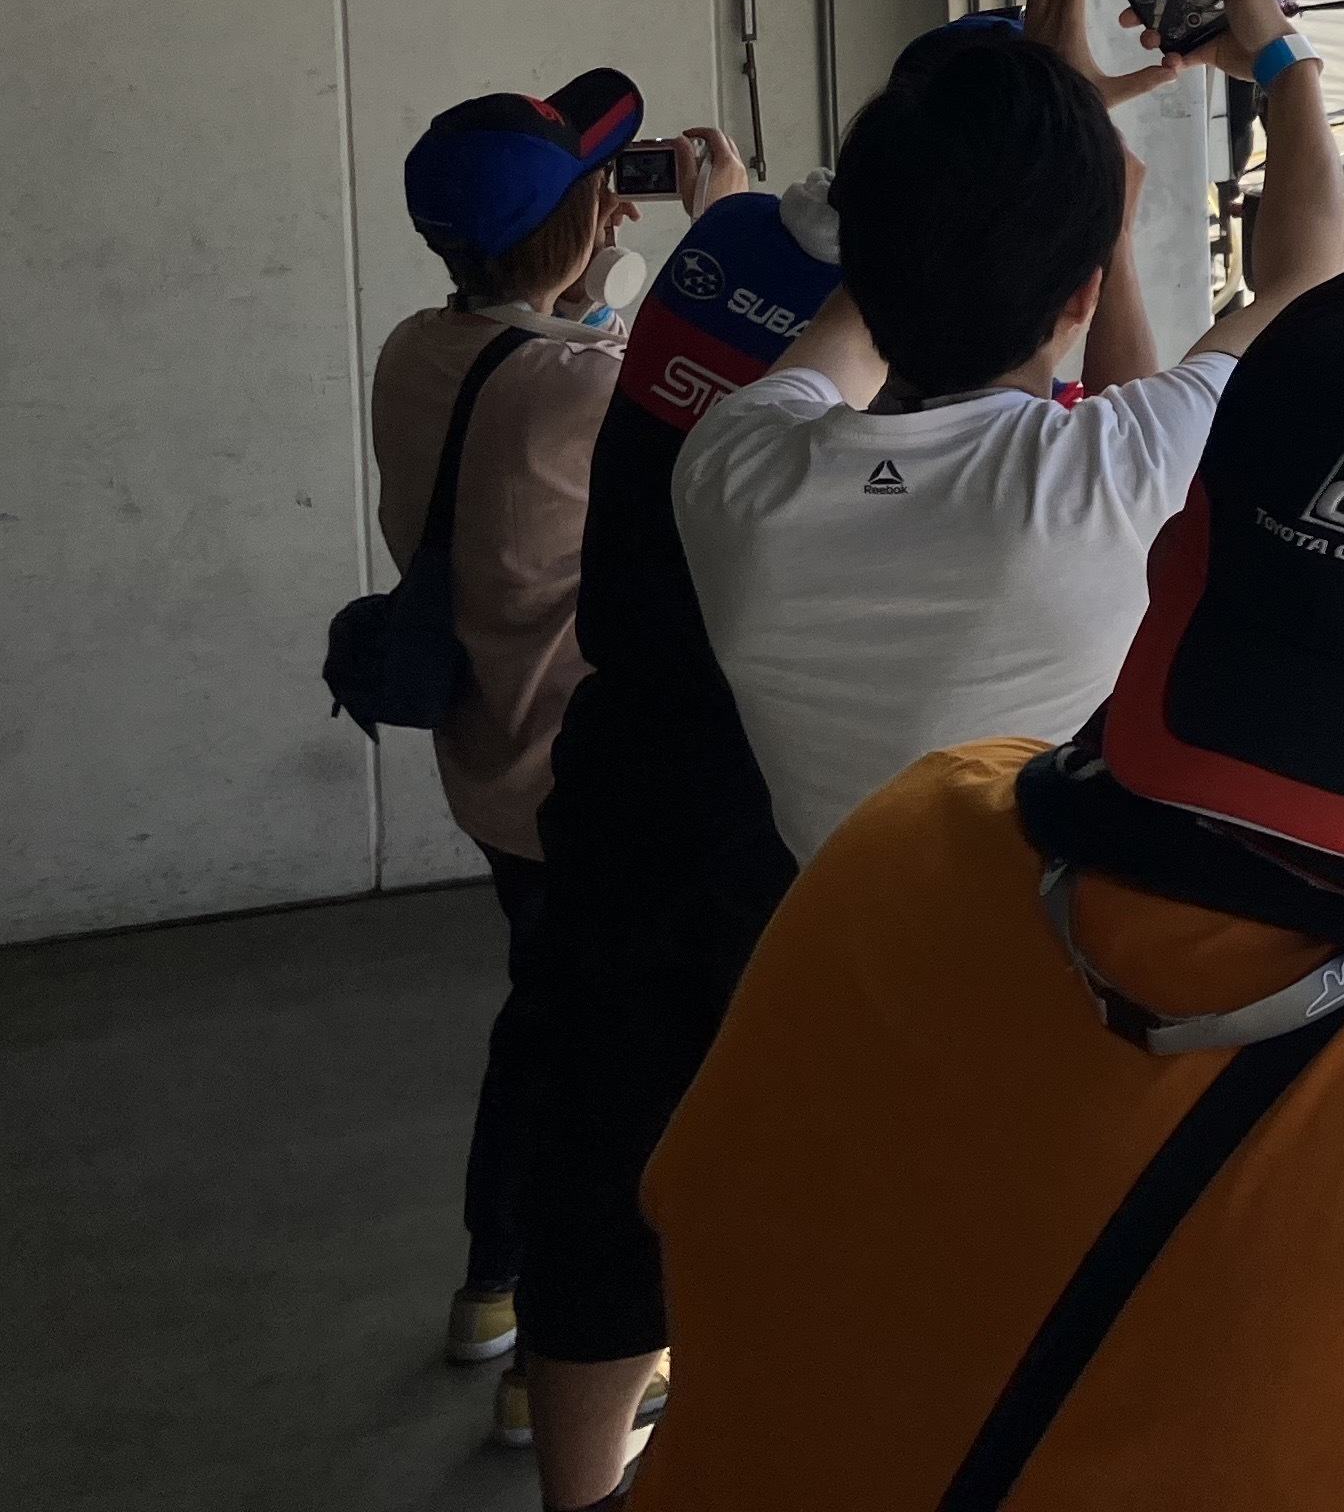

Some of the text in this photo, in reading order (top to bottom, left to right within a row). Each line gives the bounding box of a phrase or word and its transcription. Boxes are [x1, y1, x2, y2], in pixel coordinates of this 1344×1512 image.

[727, 287, 811, 339] SUBA
[864, 484, 909, 495] Reebok
[1254, 506, 1328, 555] TOYOTA
